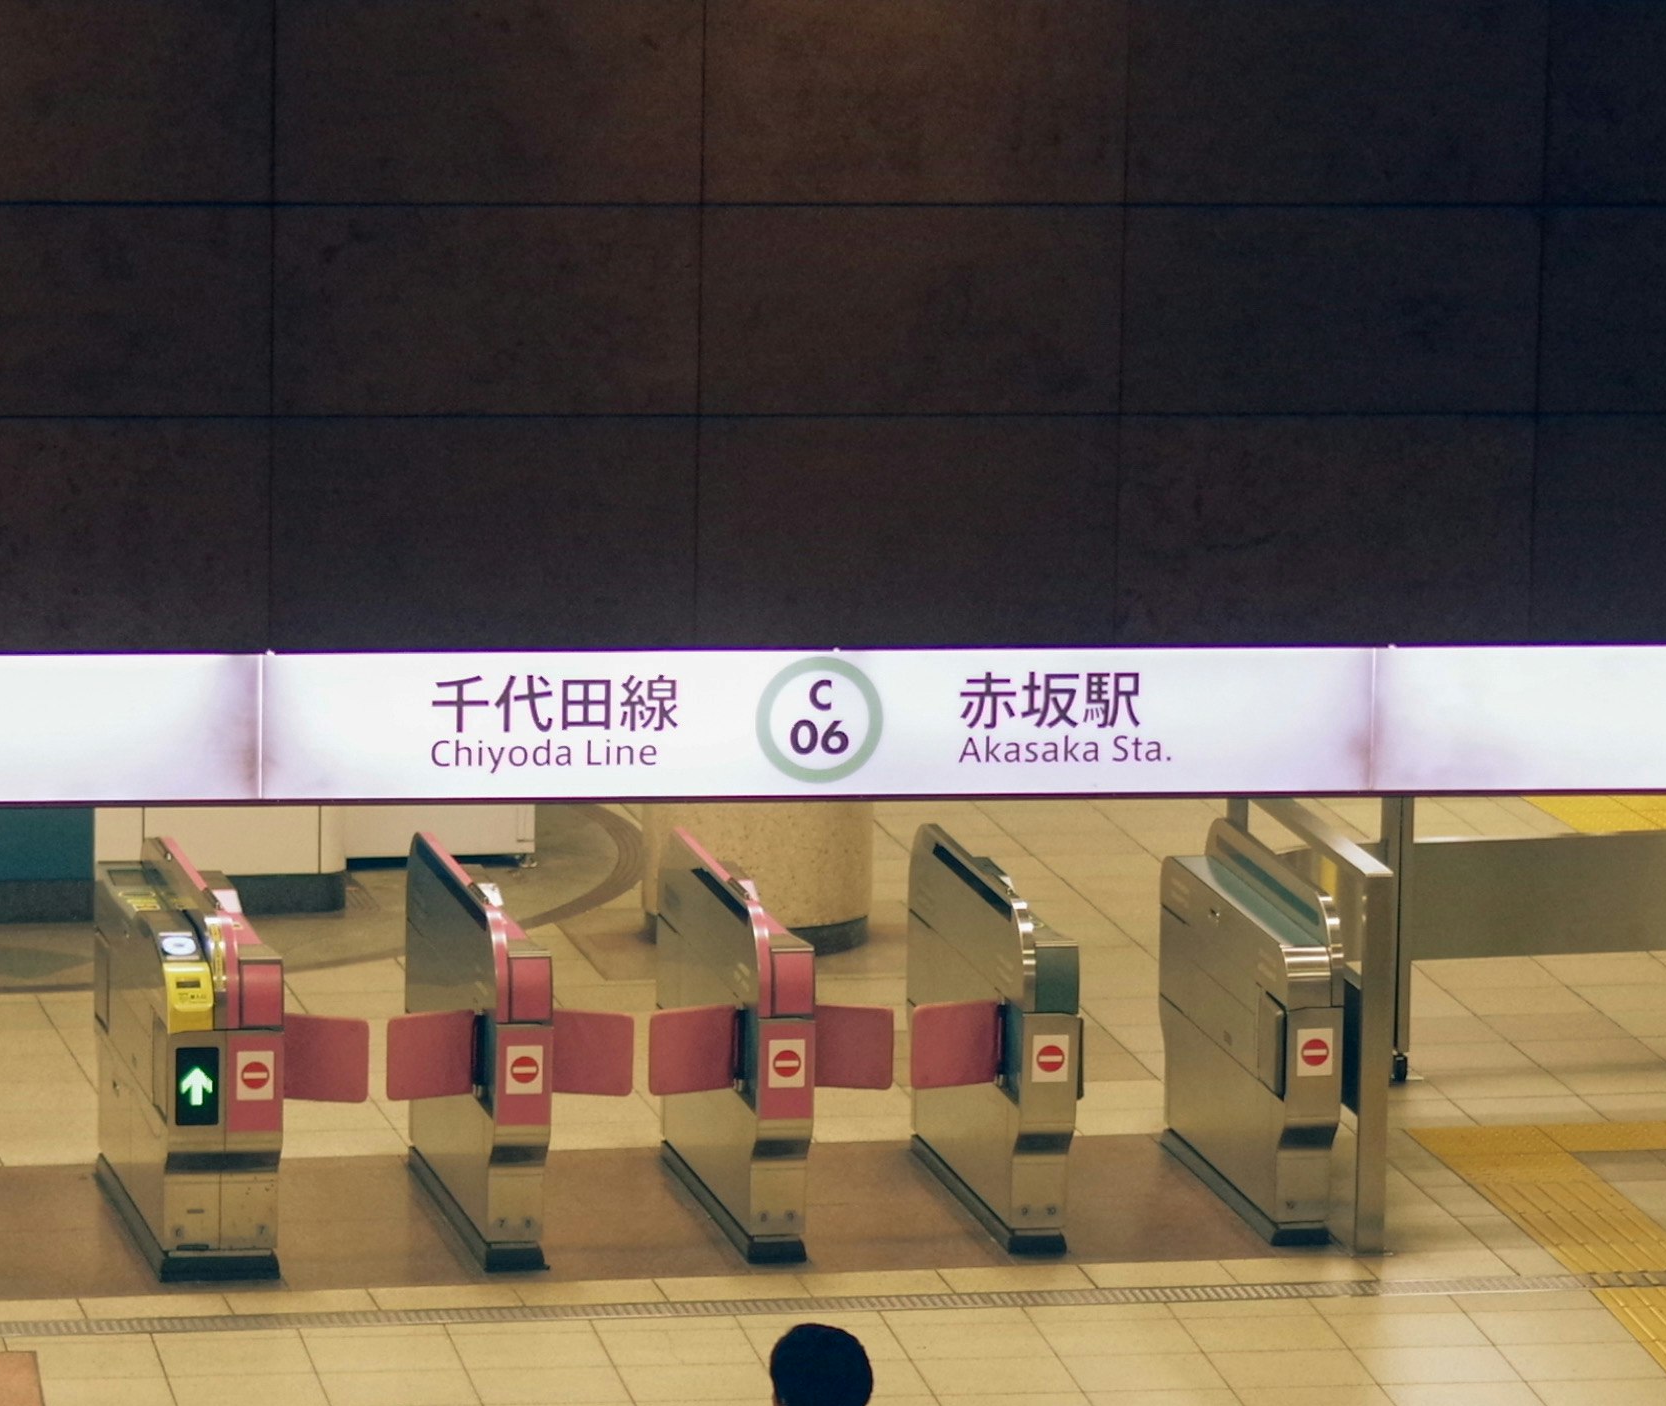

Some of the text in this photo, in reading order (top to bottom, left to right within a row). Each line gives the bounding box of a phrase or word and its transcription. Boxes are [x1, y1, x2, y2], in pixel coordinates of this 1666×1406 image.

[431, 674, 679, 733] 千代田線
[808, 679, 833, 712] C
[959, 671, 1141, 730] 赤坂駅
[789, 718, 850, 756] 06
[958, 735, 1172, 764] Akasaka Sta.
[430, 738, 658, 774] Chiyoda Line
